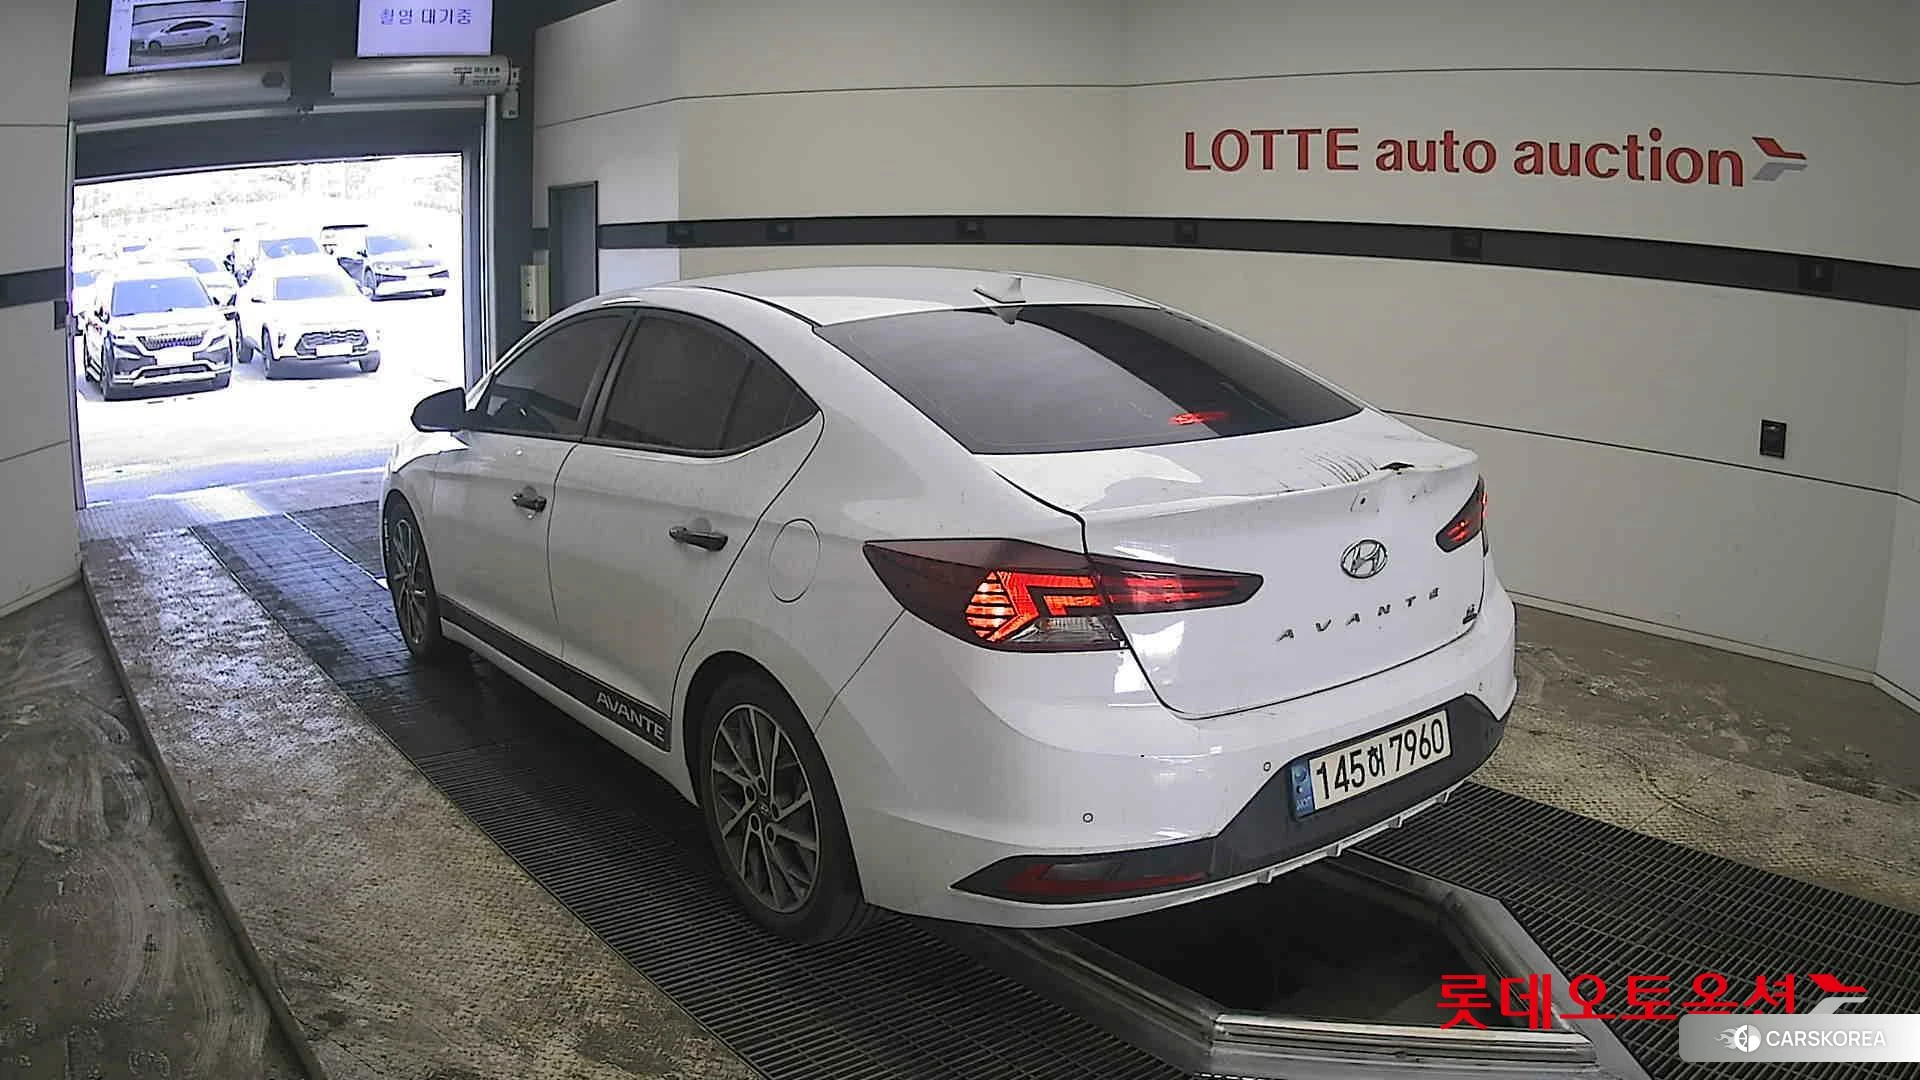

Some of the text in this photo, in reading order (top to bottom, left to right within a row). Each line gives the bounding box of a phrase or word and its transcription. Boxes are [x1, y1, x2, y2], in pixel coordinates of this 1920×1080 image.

[421, 8, 473, 25] 대기중
[1185, 127, 1744, 187] LOTTE auto auction
[1275, 587, 1440, 642] AVANTE
[596, 691, 665, 743] AVANTE
[1389, 718, 1445, 772] 7960
